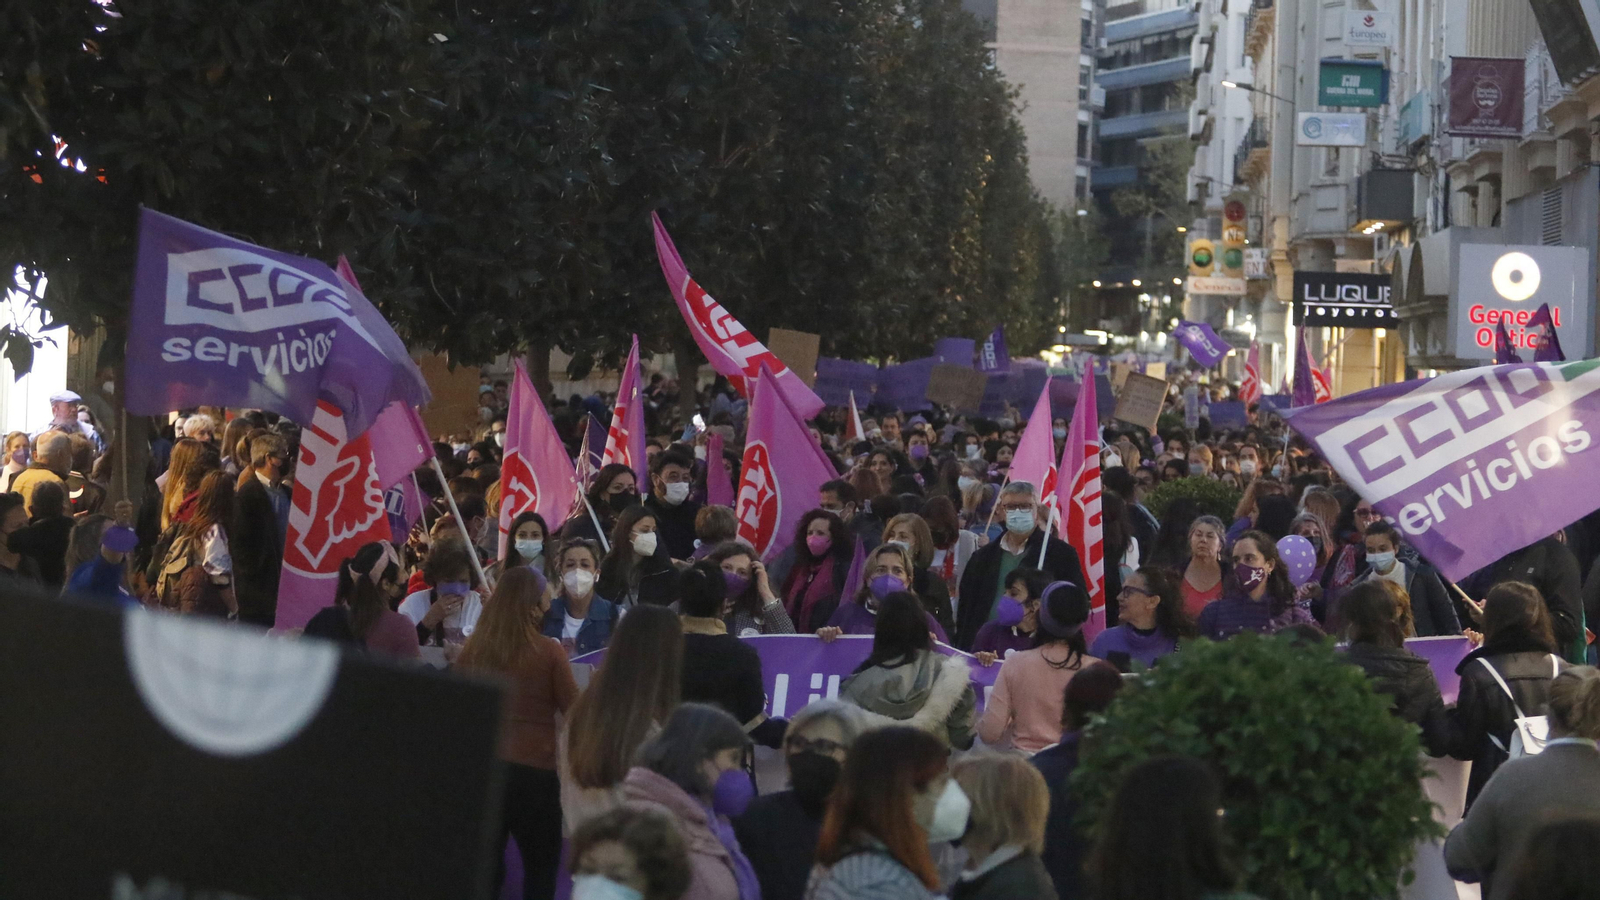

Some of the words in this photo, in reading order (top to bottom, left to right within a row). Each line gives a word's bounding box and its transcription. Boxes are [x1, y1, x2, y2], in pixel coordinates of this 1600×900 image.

[1304, 283, 1391, 303] LUQUE
[1469, 304, 1562, 327] Genel
[161, 326, 337, 376] servicios
[1342, 361, 1555, 485] CCOO
